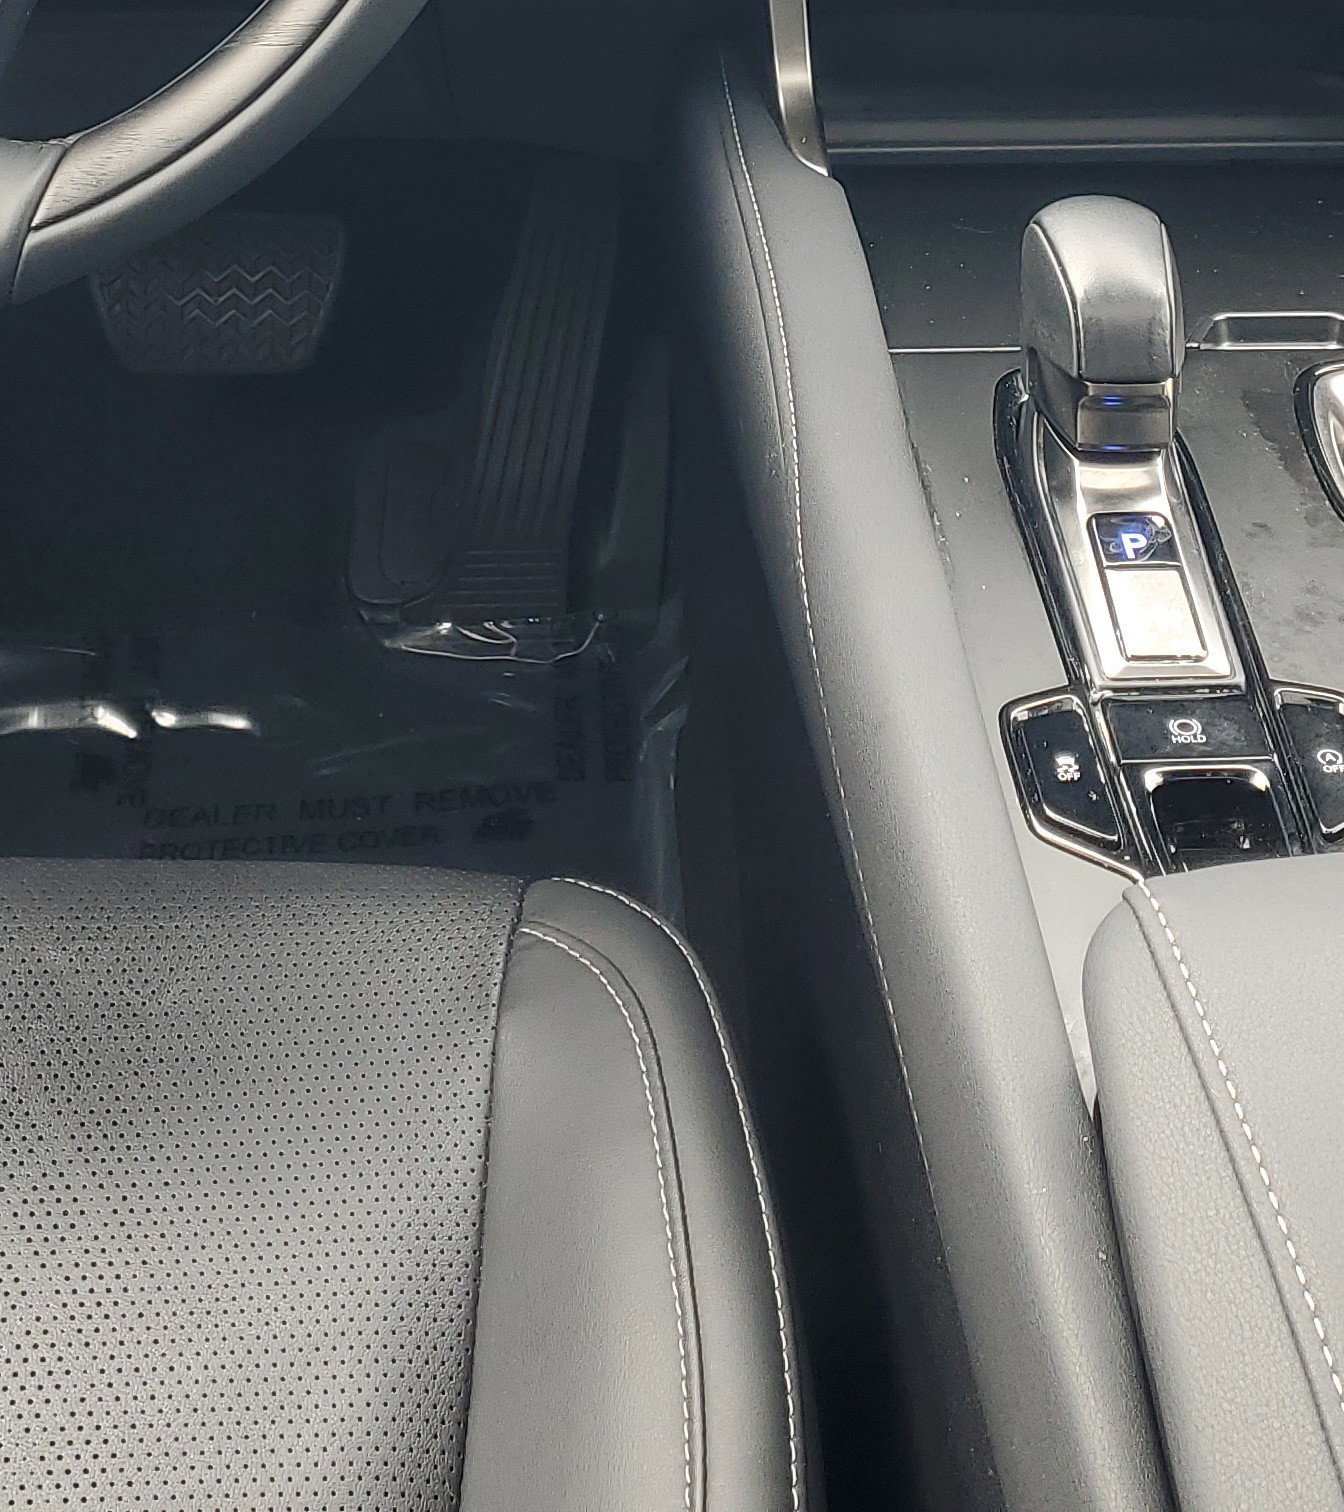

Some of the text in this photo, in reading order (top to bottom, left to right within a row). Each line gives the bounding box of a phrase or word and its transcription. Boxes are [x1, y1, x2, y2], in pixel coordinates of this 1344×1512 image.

[1121, 533, 1147, 559] P
[1171, 734, 1206, 744] HOLD
[1058, 771, 1081, 782] OFF
[298, 792, 392, 823] MUST
